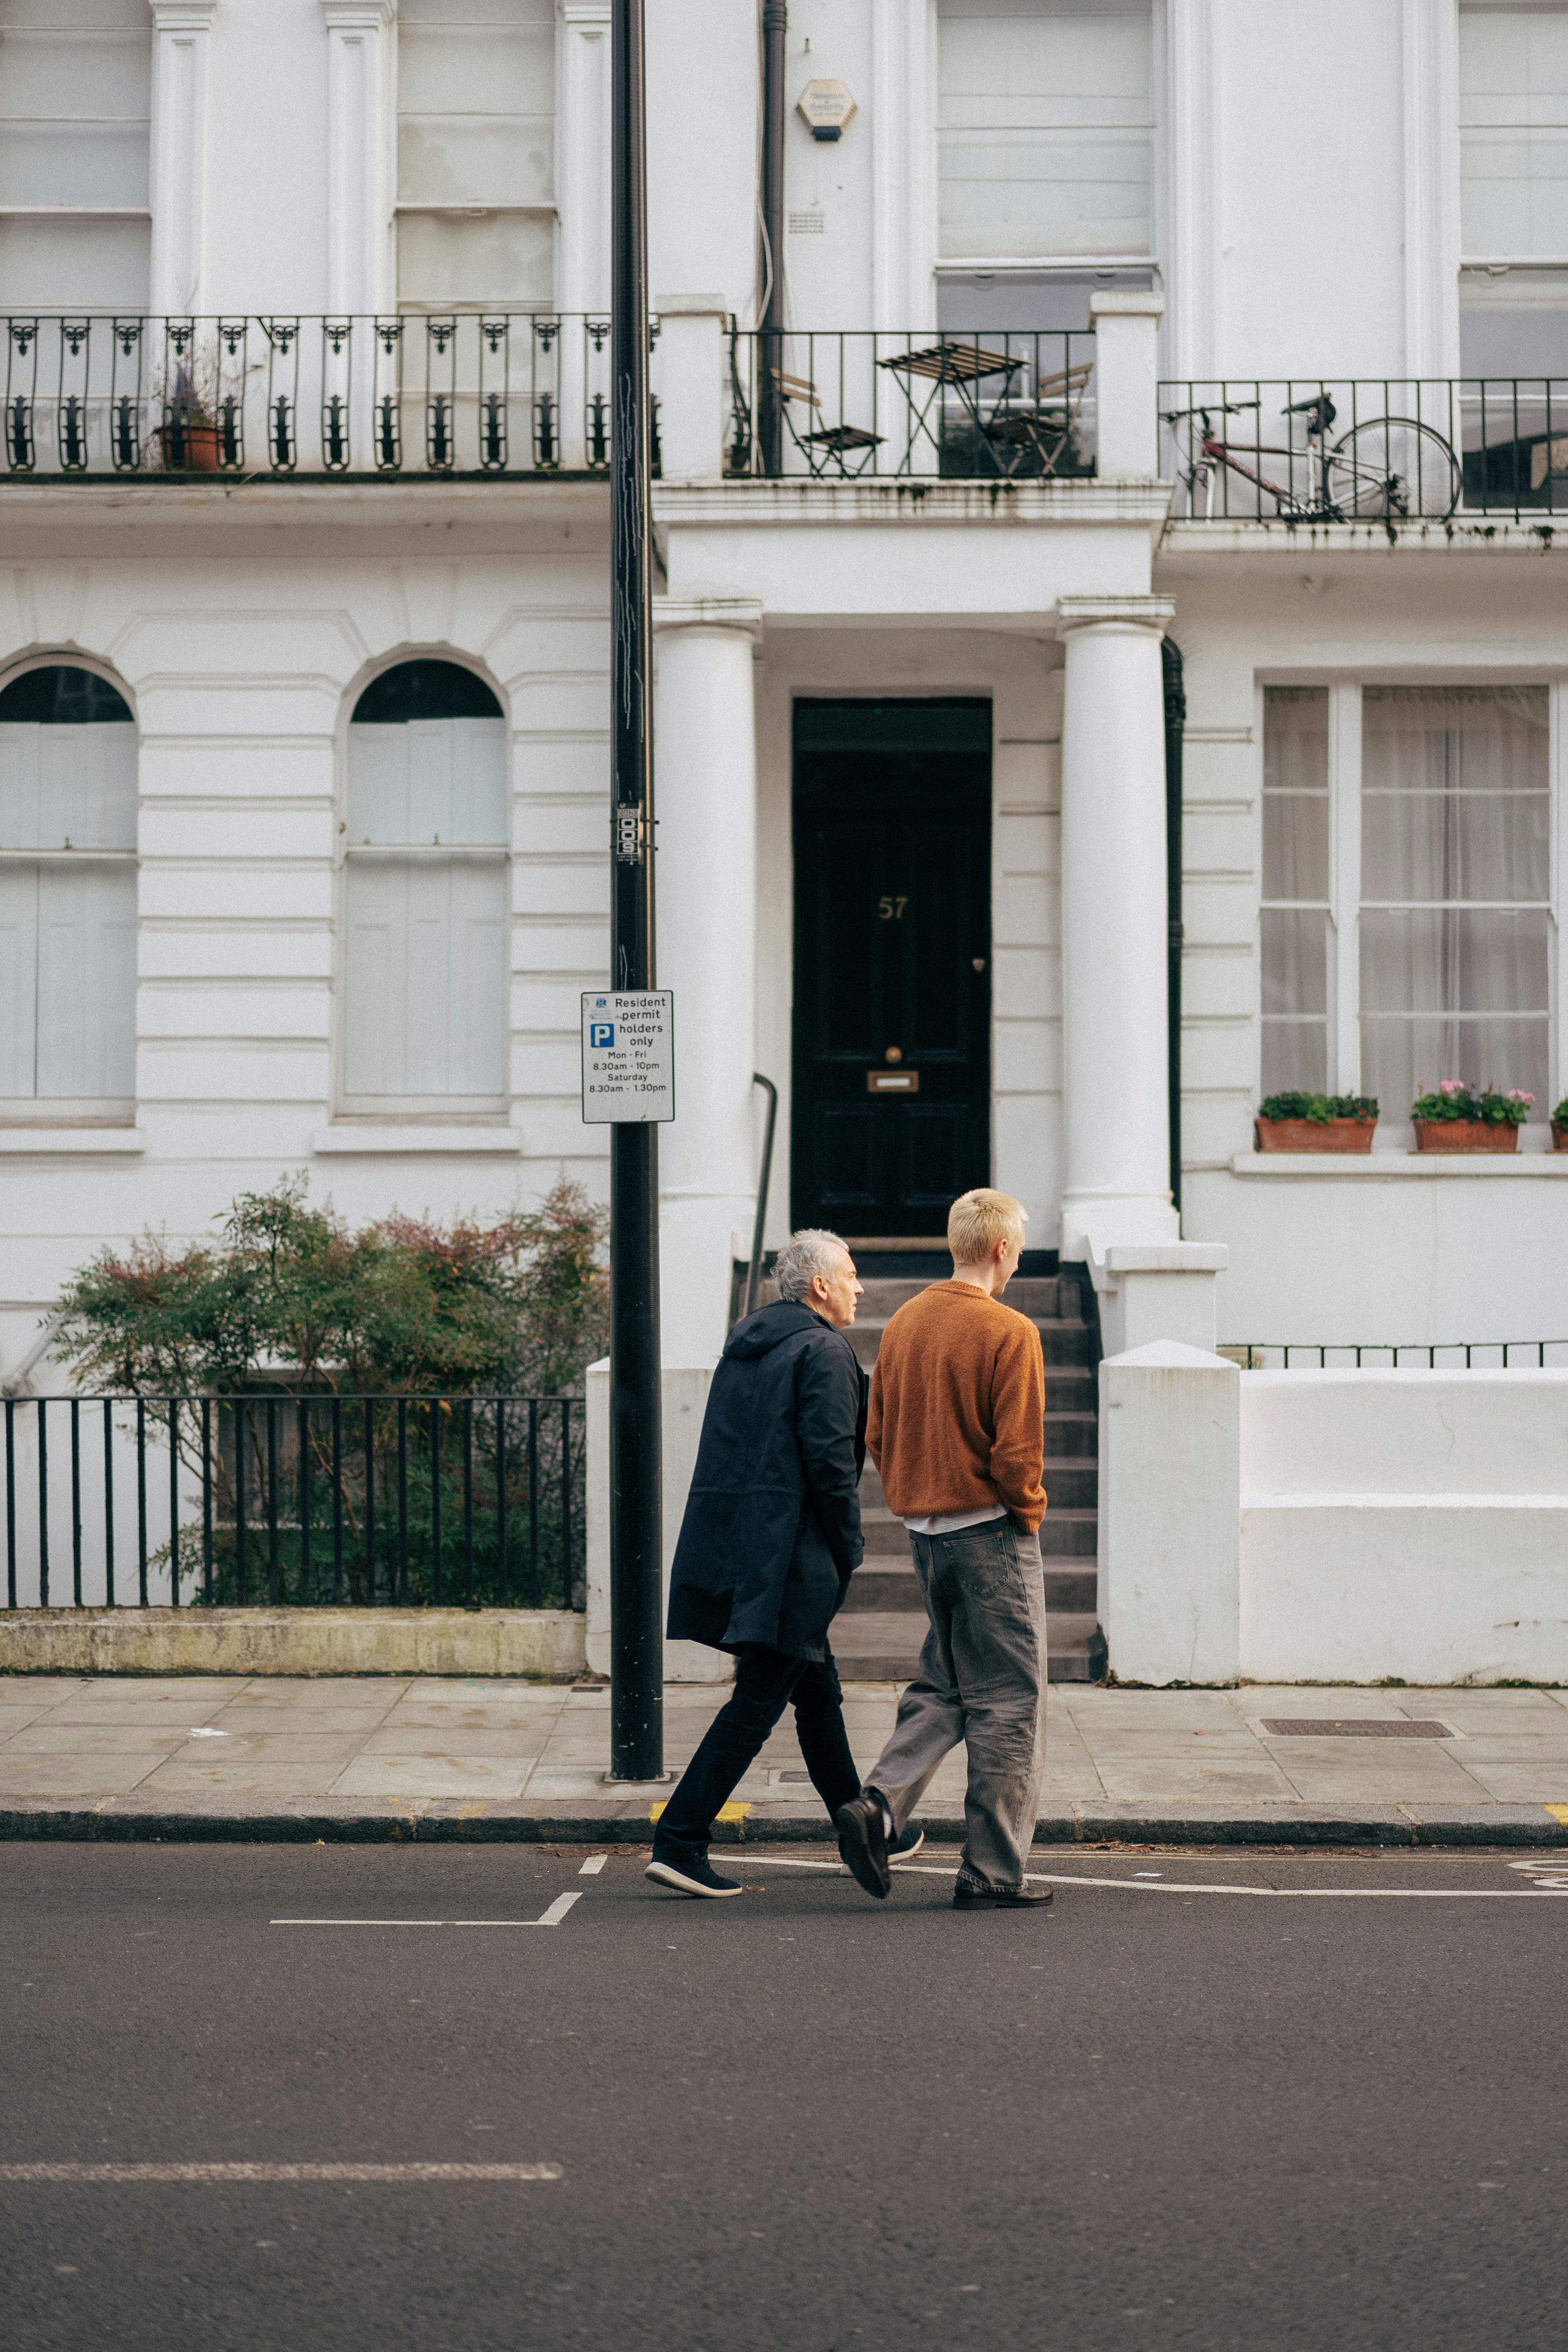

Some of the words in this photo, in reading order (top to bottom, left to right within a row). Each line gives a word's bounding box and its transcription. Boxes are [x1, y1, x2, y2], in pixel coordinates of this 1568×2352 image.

[879, 897, 907, 918] 57
[616, 997, 666, 1007] Resident
[622, 1010, 660, 1022] permit
[620, 1024, 663, 1033] holders
[595, 1026, 610, 1046] P
[630, 1037, 653, 1047] only
[637, 1062, 659, 1071] 10pm
[608, 1073, 647, 1082] Saturday
[635, 1084, 666, 1093] 1.30pm
